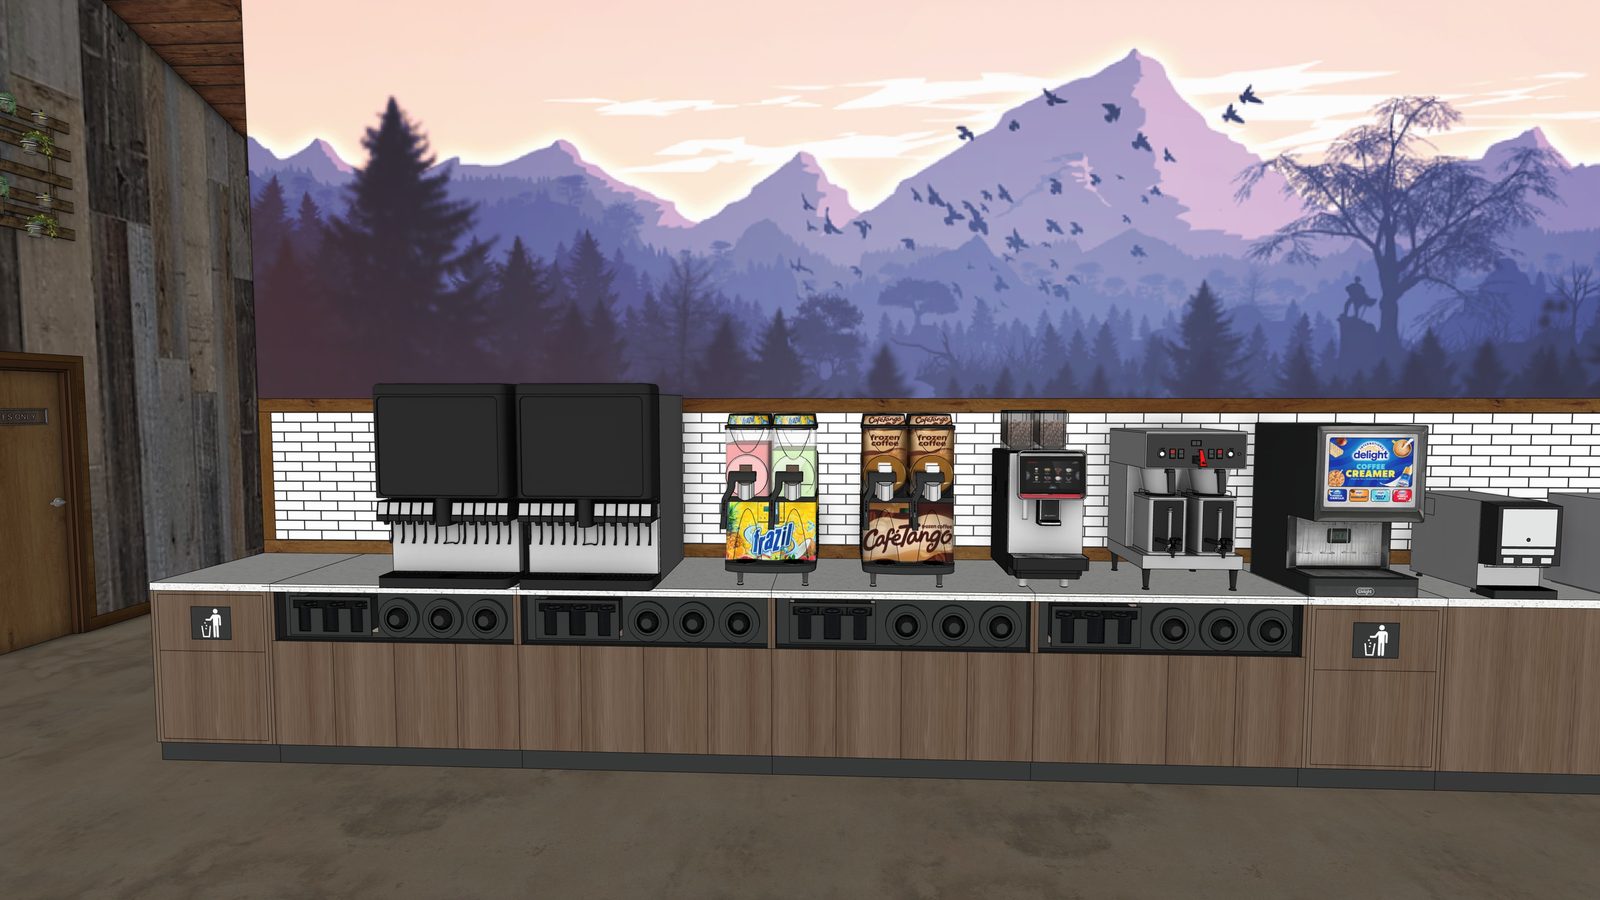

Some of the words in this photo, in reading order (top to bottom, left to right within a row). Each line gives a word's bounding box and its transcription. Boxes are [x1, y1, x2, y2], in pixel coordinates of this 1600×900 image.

[870, 434, 900, 442] frozen
[917, 434, 947, 442] frozen
[1353, 450, 1388, 461] delight
[1346, 469, 1396, 478] CREAMER
[753, 523, 793, 555] frazil
[863, 523, 953, 553] CaféTango
